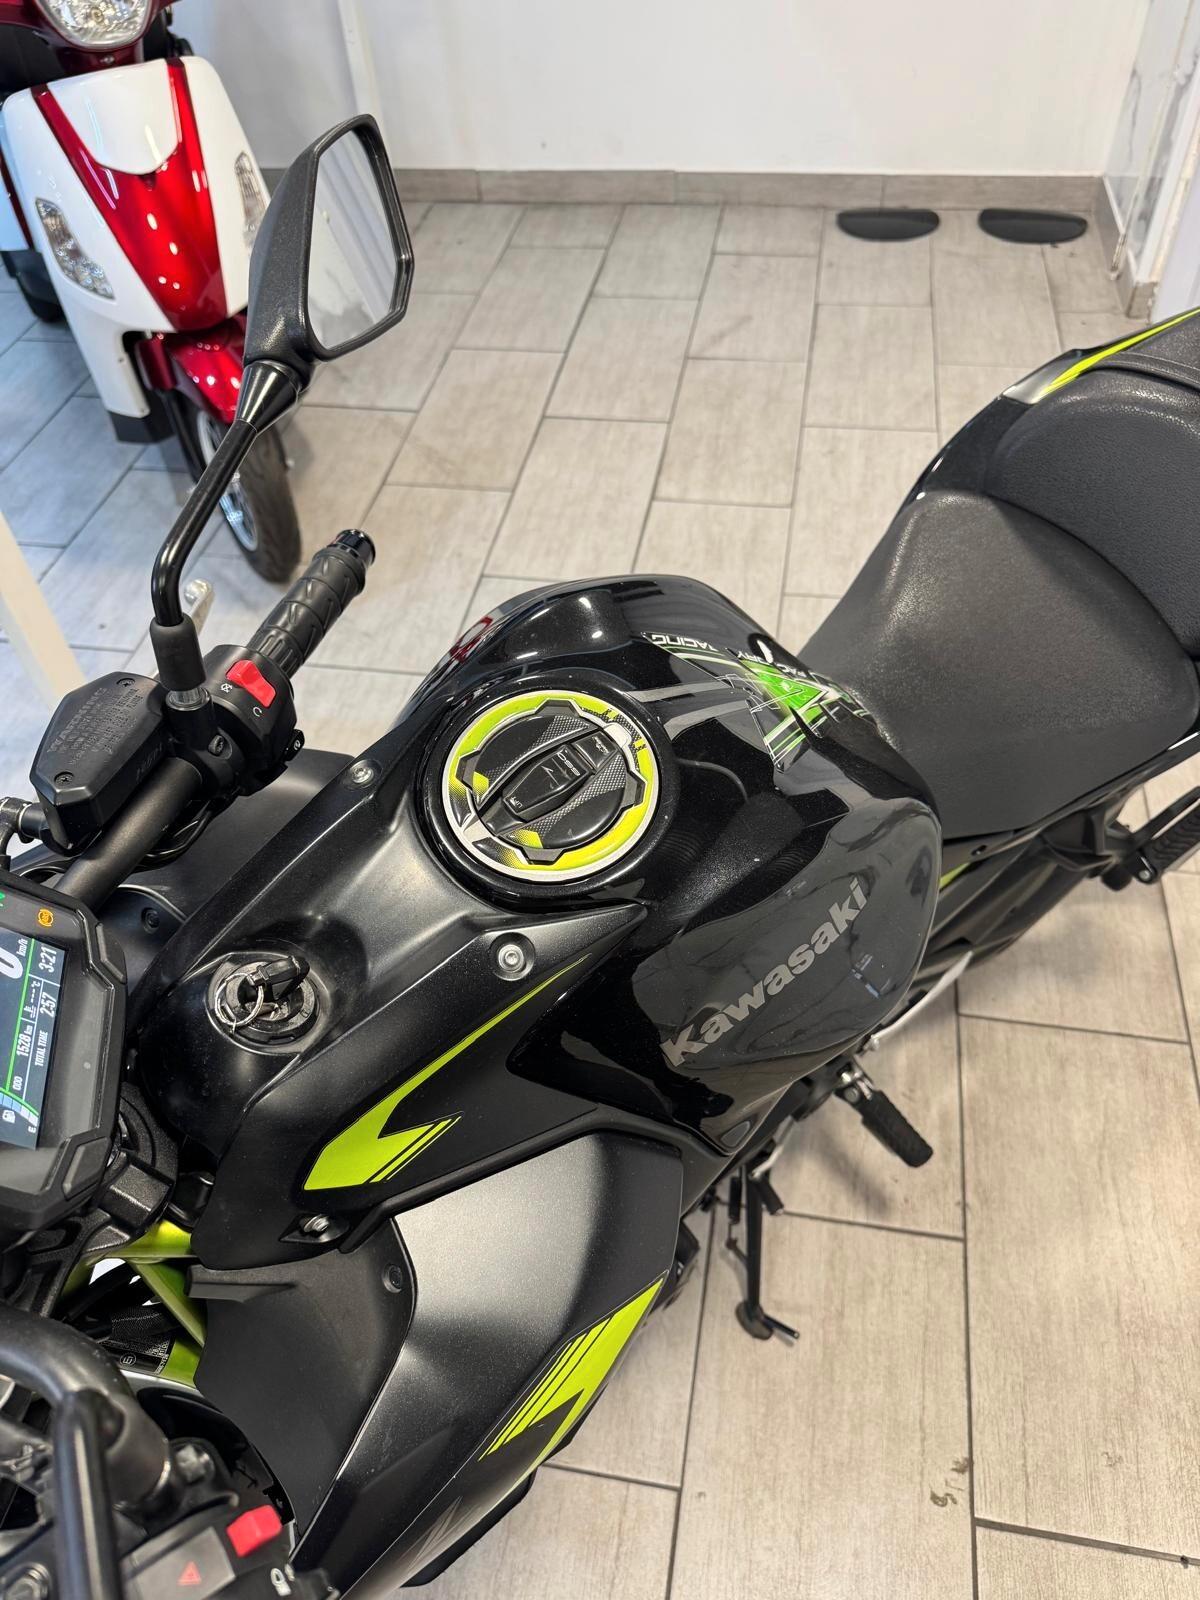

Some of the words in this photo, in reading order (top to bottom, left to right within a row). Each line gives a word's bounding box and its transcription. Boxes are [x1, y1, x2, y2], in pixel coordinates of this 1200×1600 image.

[38, 946, 57, 973] 3:21
[660, 877, 867, 1067] Kawasaki
[34, 1046, 46, 1067] TOTAL
[40, 991, 57, 1018] 2:57
